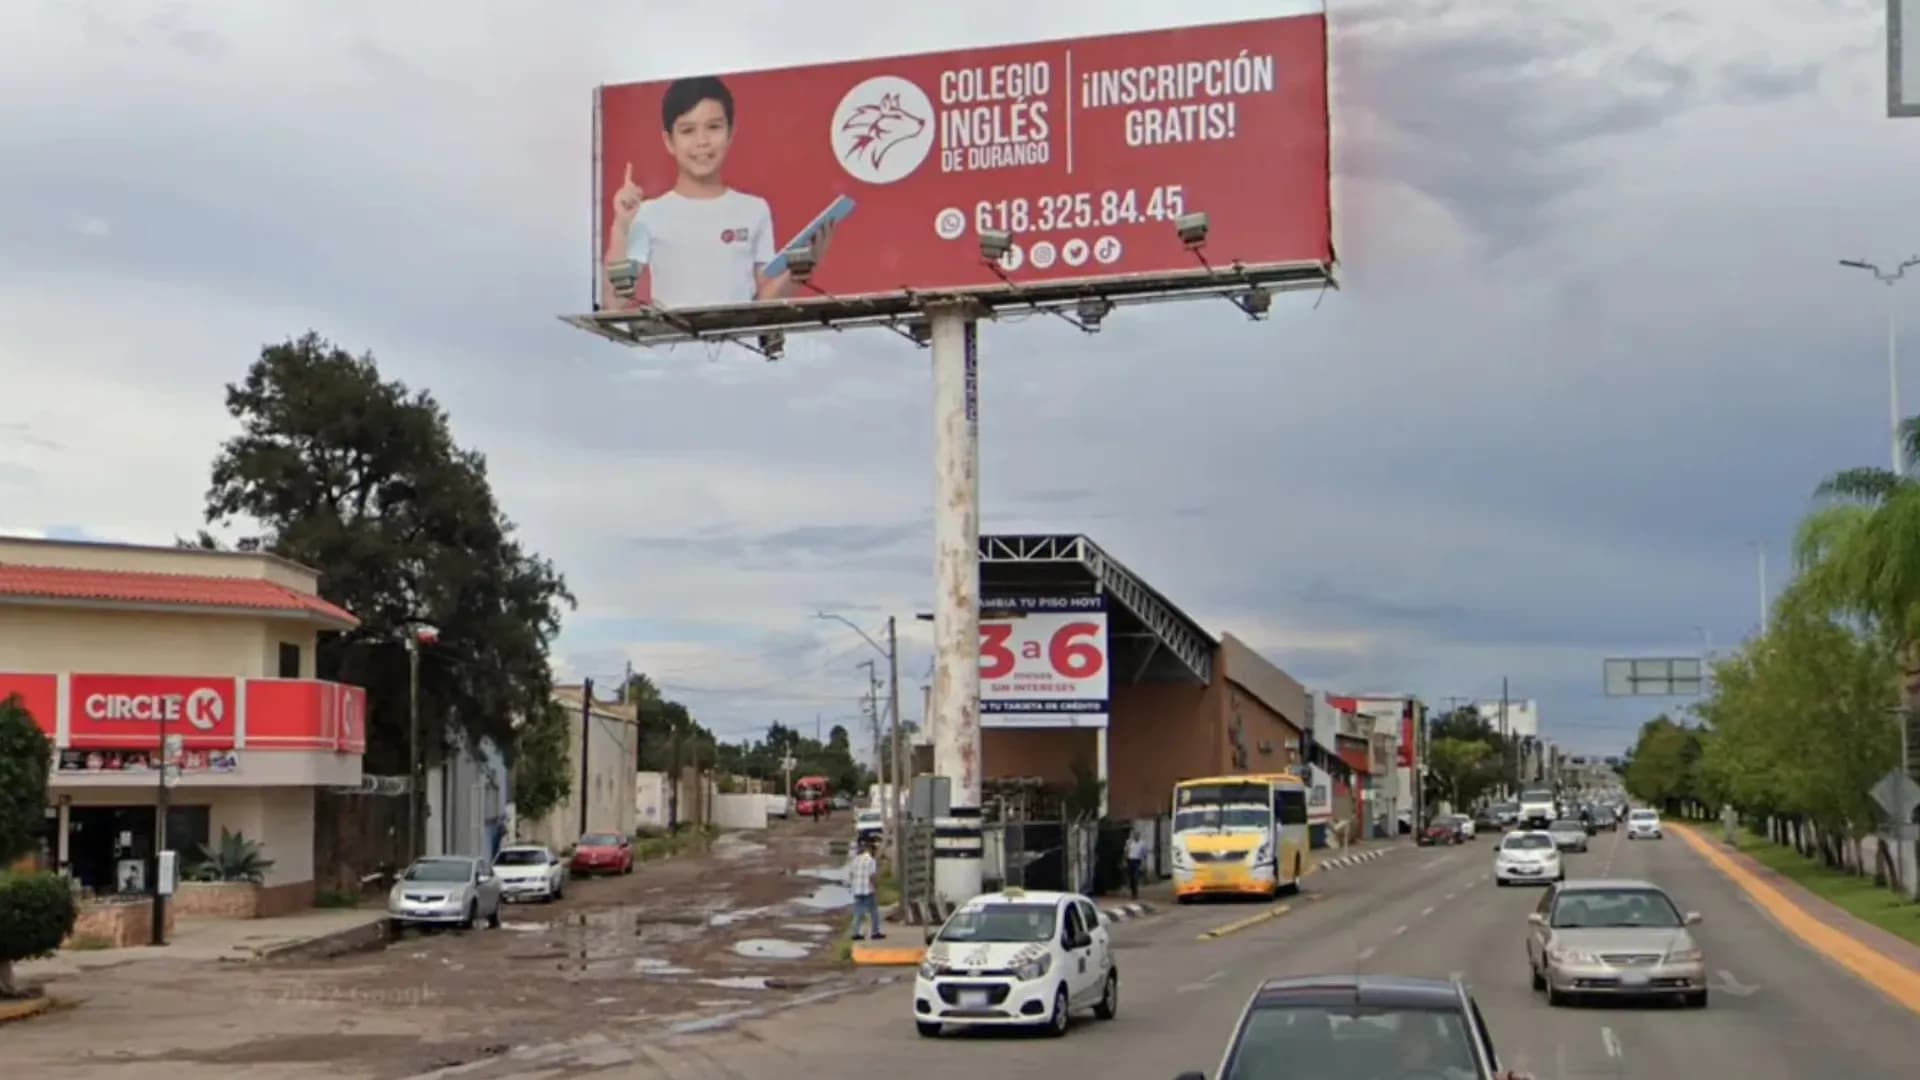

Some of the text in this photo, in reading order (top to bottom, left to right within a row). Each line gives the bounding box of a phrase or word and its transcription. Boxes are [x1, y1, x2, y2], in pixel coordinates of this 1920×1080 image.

[940, 61, 1050, 104] COLEGIO
[1082, 49, 1273, 109] ¡INSCRIPCIÓN
[941, 95, 1049, 149] INGLÉS
[1125, 101, 1236, 147] GRATIS!
[941, 141, 1050, 173] DE DURANGO
[975, 185, 1184, 235] 618.325.84.45
[1021, 598, 1036, 608] TU
[1039, 598, 1068, 608] PISO
[979, 622, 1103, 680] 3 a 6
[85, 693, 181, 720] CIRCLE
